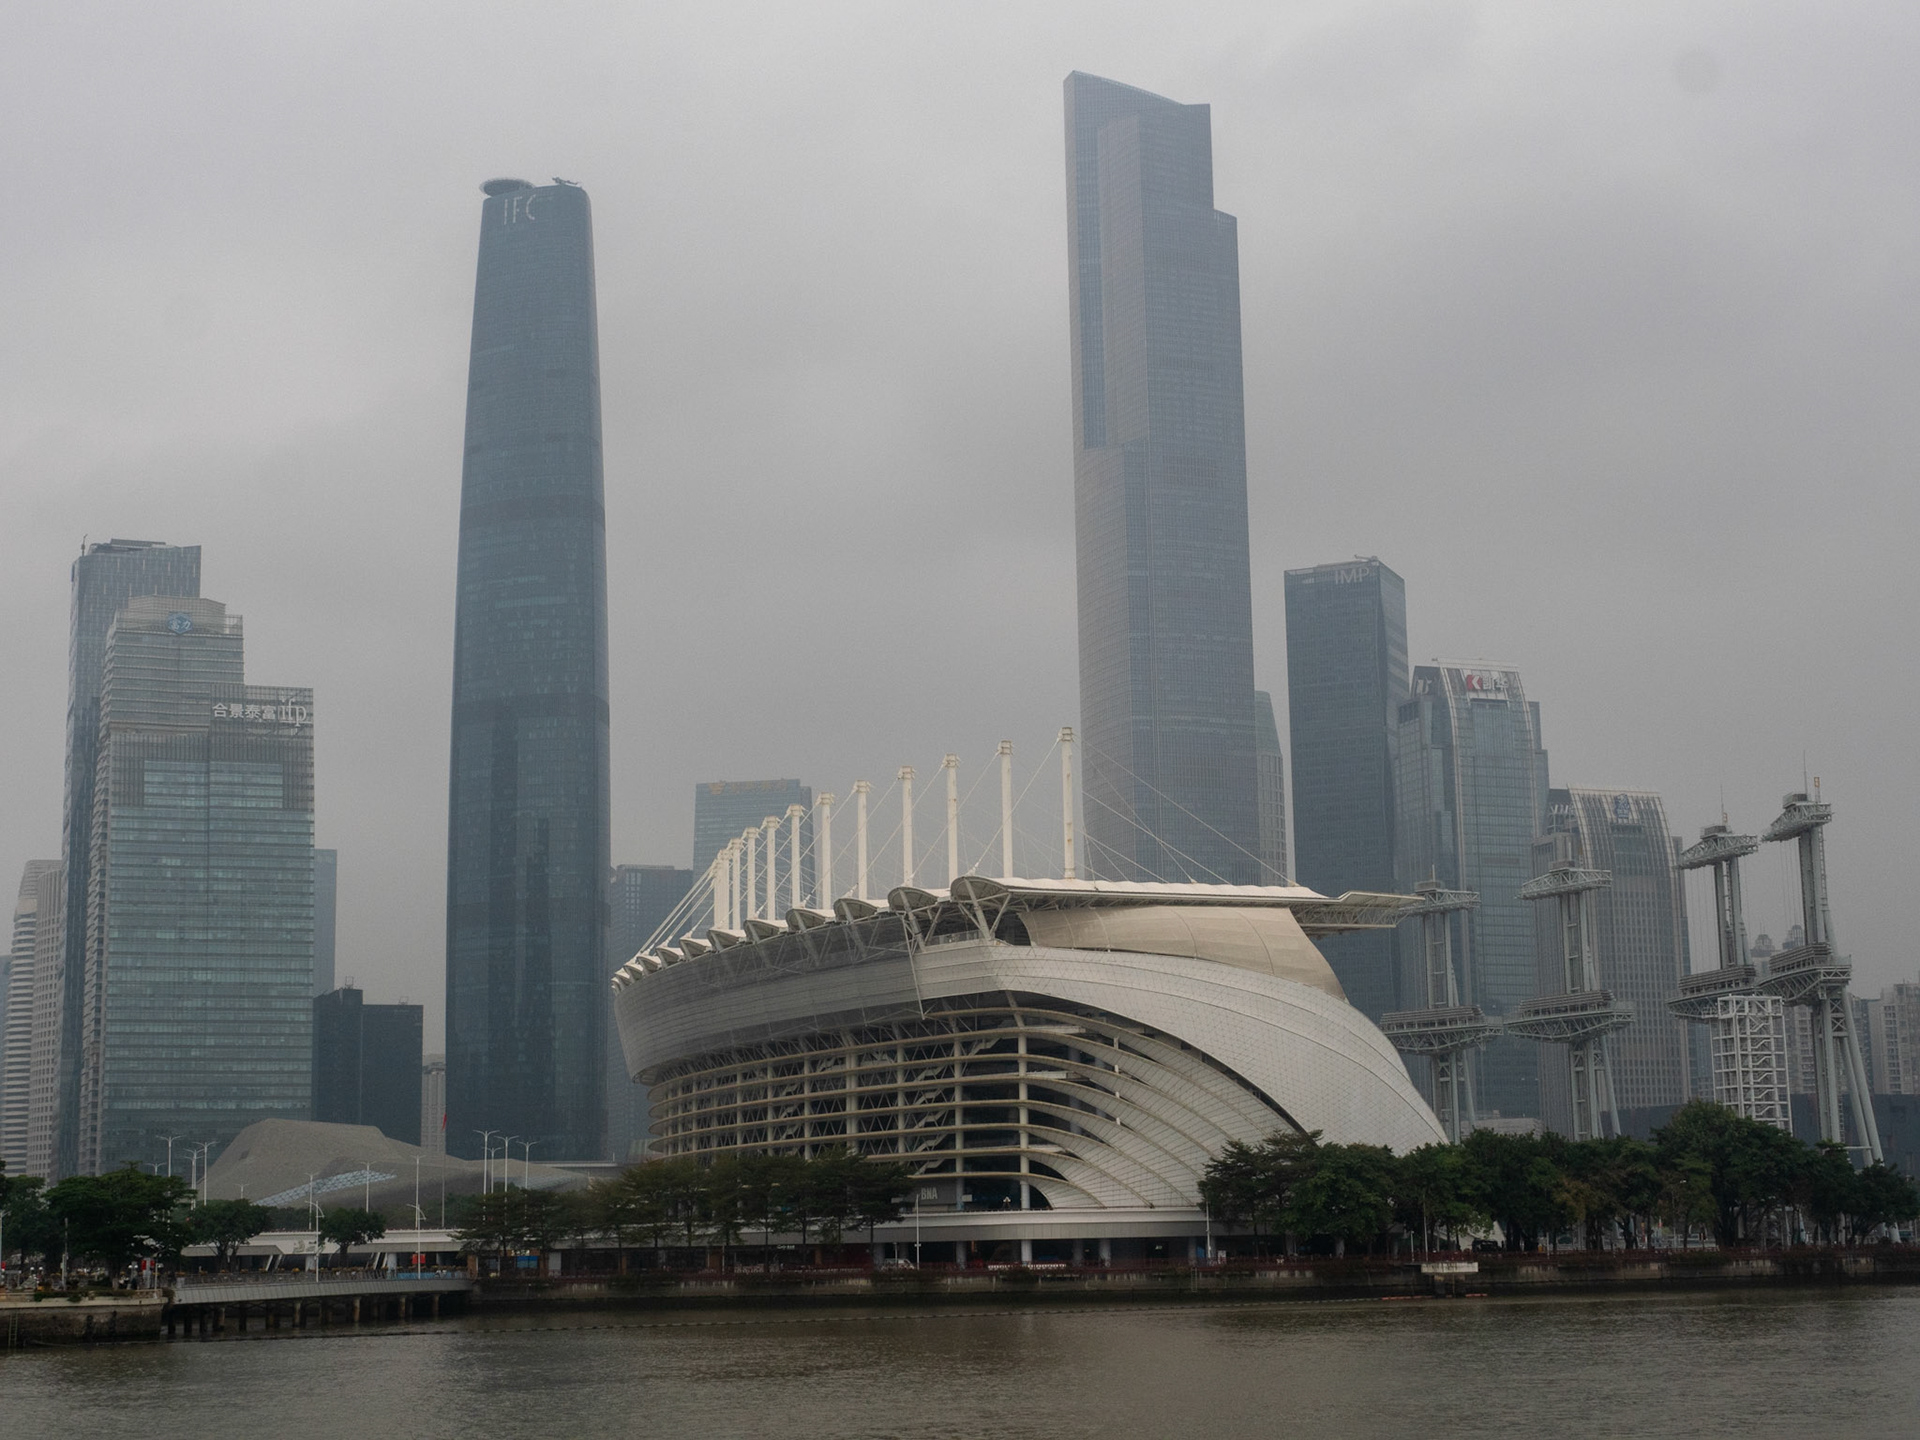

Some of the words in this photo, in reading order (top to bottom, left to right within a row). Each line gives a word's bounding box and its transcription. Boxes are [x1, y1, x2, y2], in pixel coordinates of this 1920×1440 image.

[503, 194, 537, 225] IFC
[1334, 566, 1370, 585] IMP
[211, 702, 277, 720] 合景泰富
[279, 697, 308, 727] ifp
